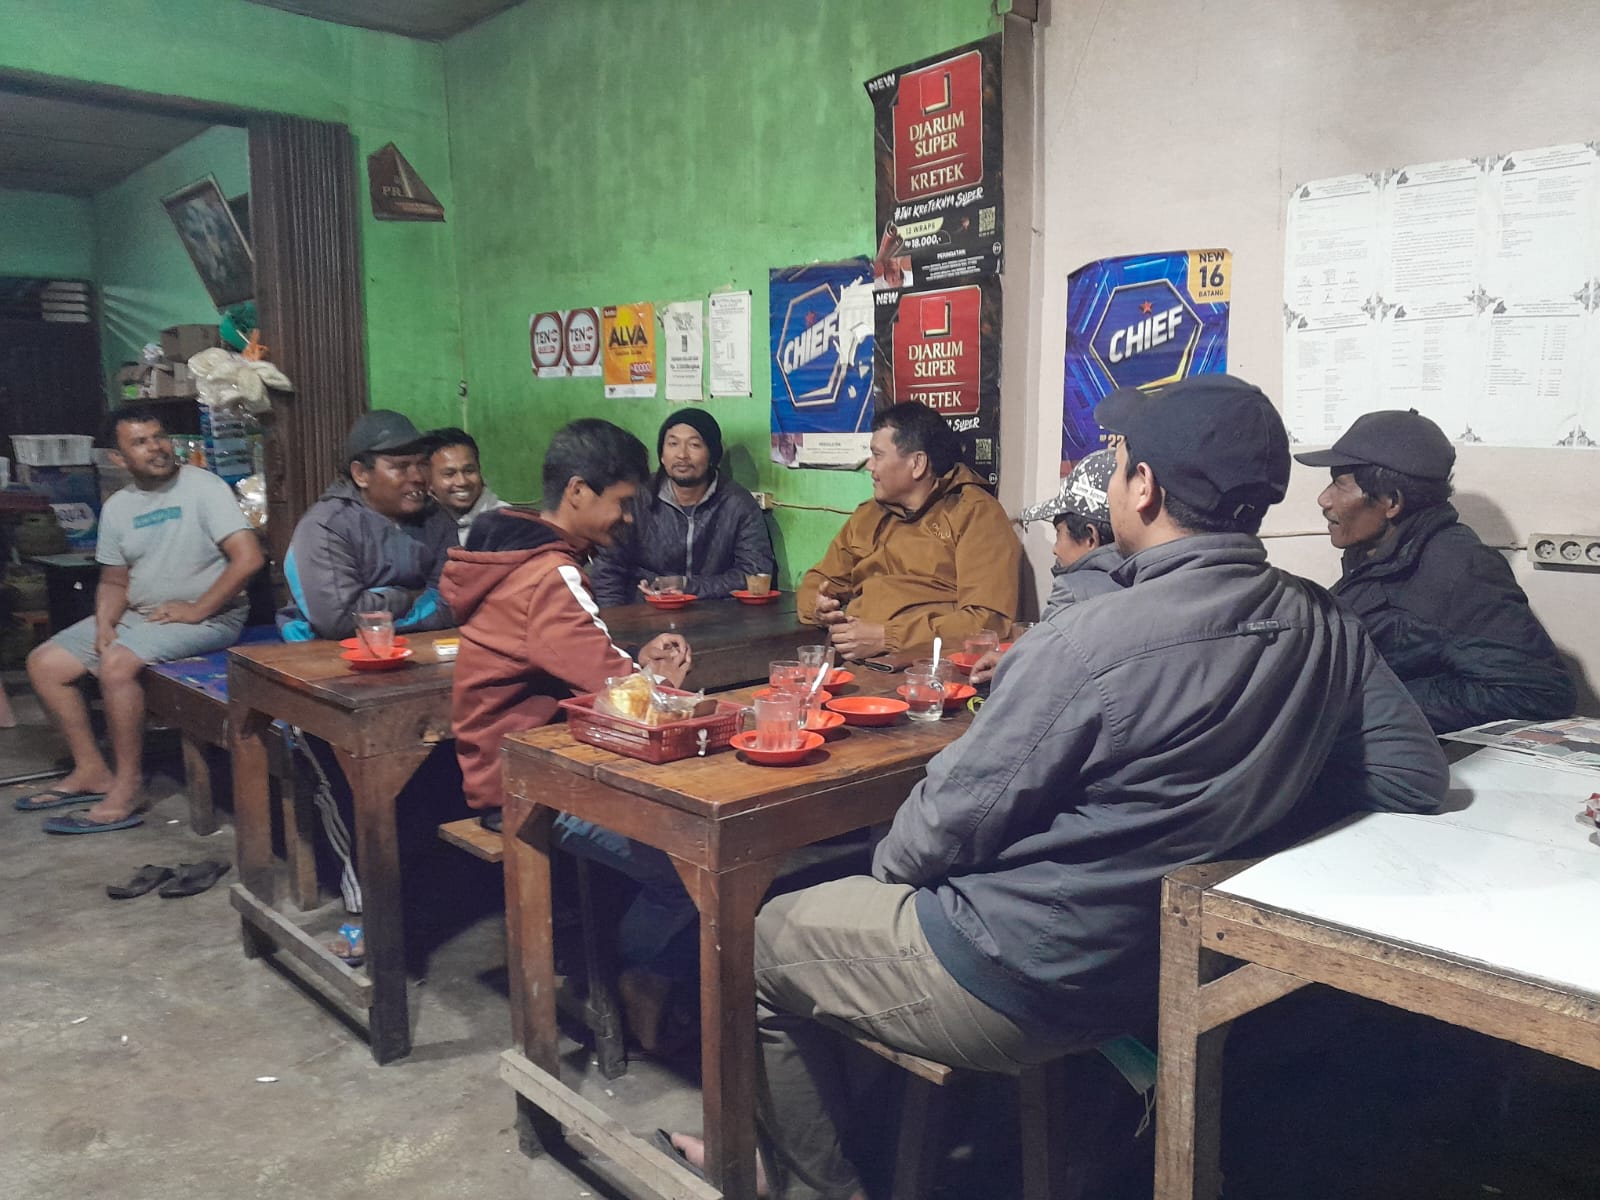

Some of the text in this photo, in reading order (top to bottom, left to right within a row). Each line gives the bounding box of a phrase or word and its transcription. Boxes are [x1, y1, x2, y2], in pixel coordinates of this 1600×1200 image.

[868, 73, 896, 93] NEW
[909, 110, 965, 141] DJARUM
[915, 133, 958, 159] SUPER
[910, 162, 965, 192] KRETEK
[955, 187, 984, 208] SUPER
[913, 222, 936, 234] WRAPS
[1199, 252, 1225, 264] NEW
[1199, 264, 1225, 289] 16
[876, 291, 899, 305] NEW
[1198, 289, 1224, 298] BATANG
[609, 324, 648, 347] ALVA
[784, 311, 840, 375] CHIEF
[1108, 304, 1184, 364] CHIEF
[908, 340, 964, 362] DJARUM
[914, 359, 956, 378] SUPER
[953, 416, 980, 432] SUPER
